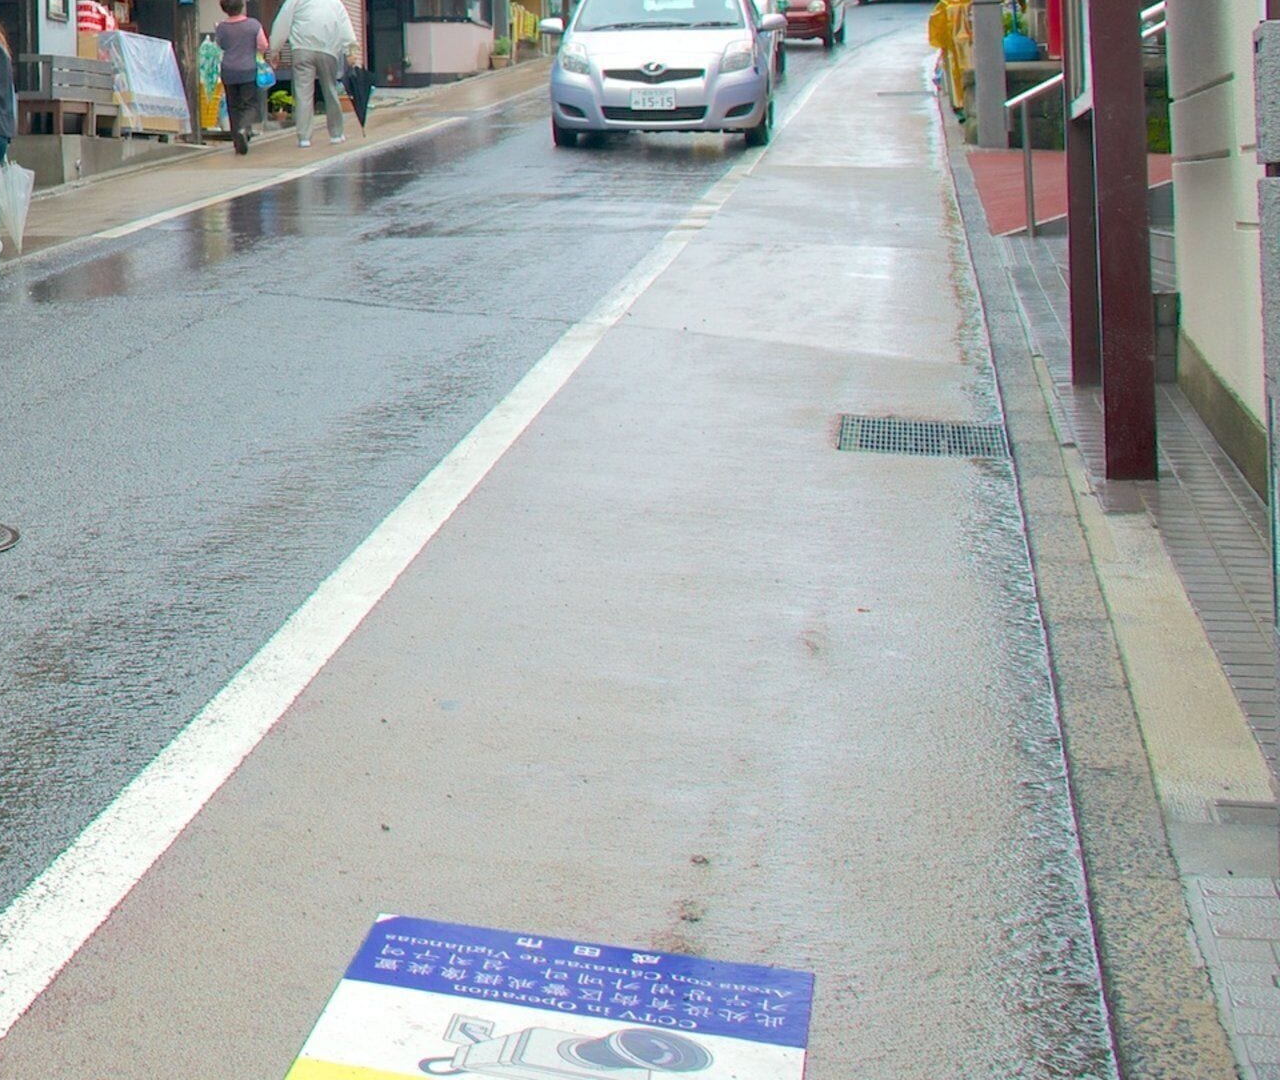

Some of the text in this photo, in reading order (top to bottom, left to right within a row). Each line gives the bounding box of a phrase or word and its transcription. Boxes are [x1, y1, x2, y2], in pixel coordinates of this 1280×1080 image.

[514, 937, 662, 965] 成田市
[519, 953, 547, 965] de
[671, 973, 713, 987] con
[453, 983, 698, 1030] CCTV in Operation
